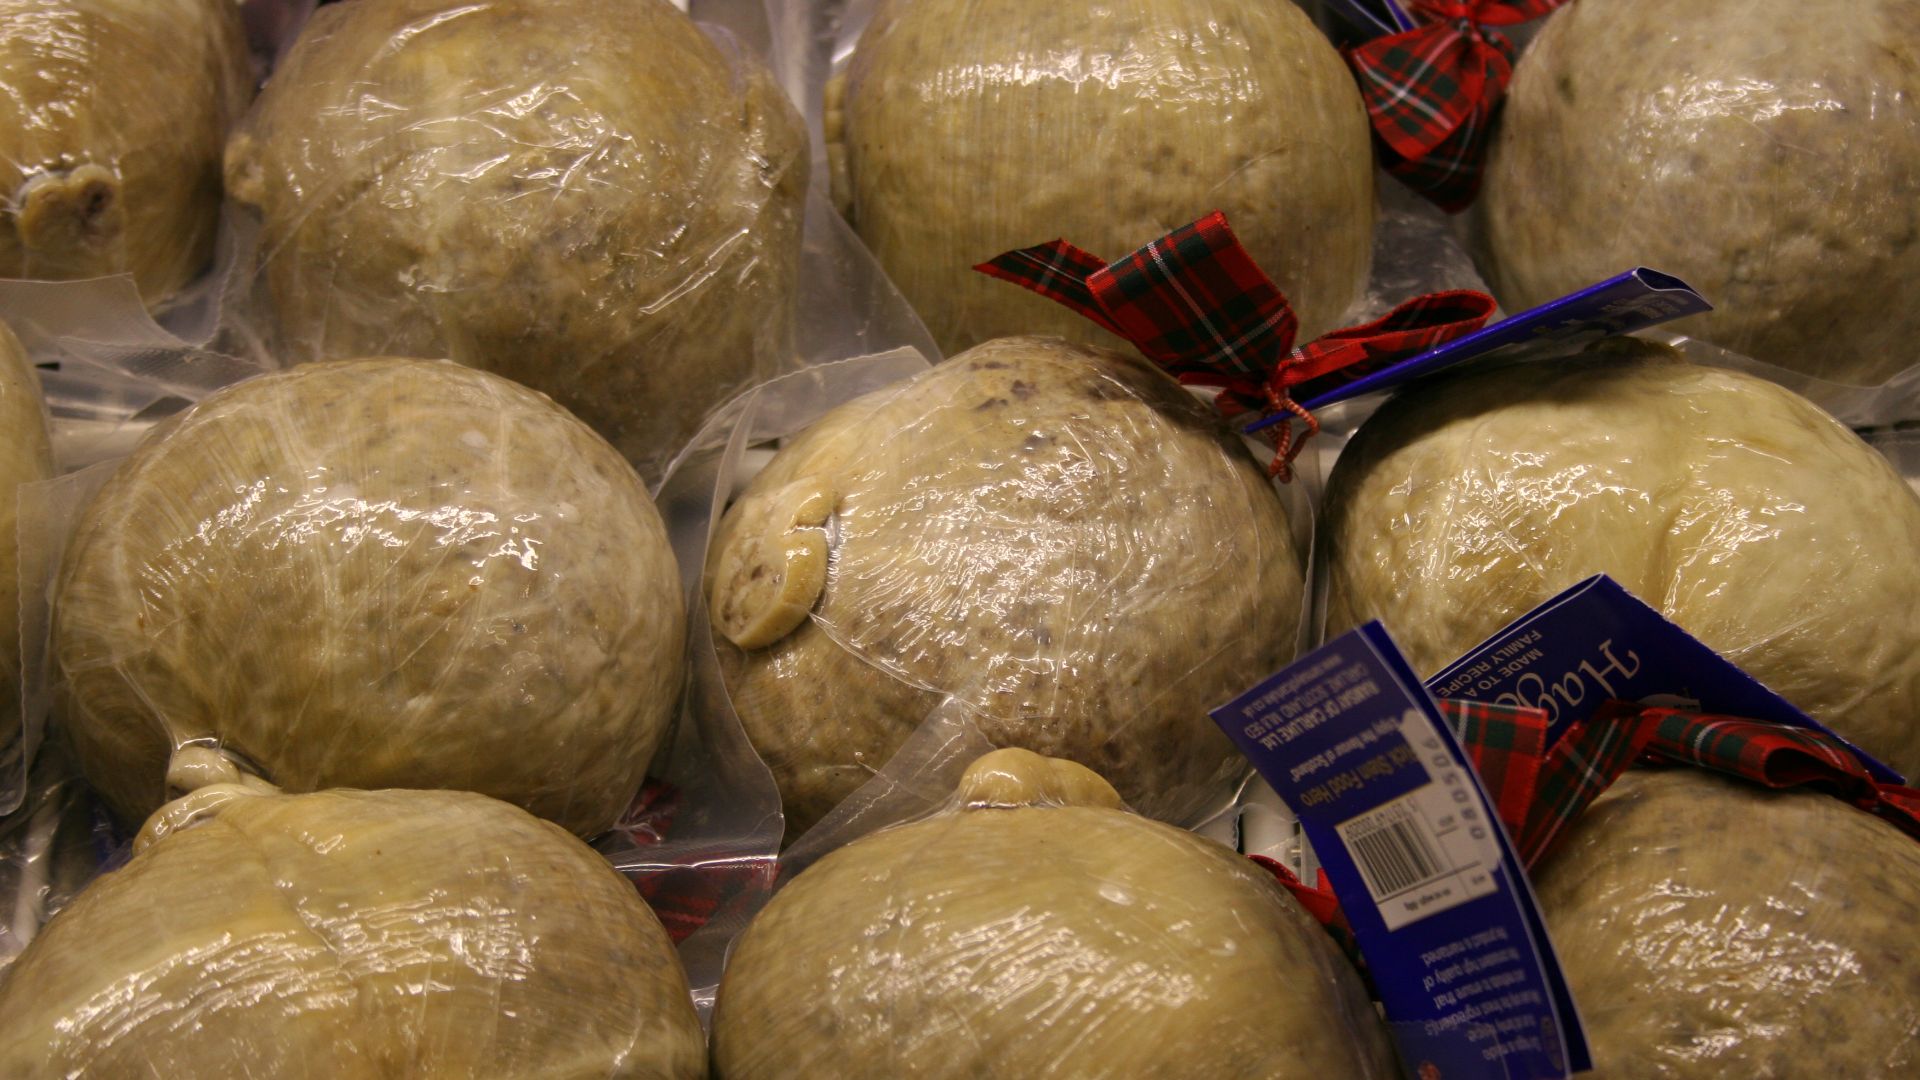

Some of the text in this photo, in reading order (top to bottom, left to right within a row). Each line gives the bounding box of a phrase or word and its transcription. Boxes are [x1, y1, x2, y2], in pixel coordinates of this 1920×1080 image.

[1436, 630, 1543, 697] FAMILY RECIPE
[1464, 648, 1544, 697] MADE TO A
[1324, 700, 1341, 718] OF
[1277, 708, 1327, 742] CARLUKE
[1300, 784, 1336, 806] Hero
[1327, 769, 1364, 798] Food
